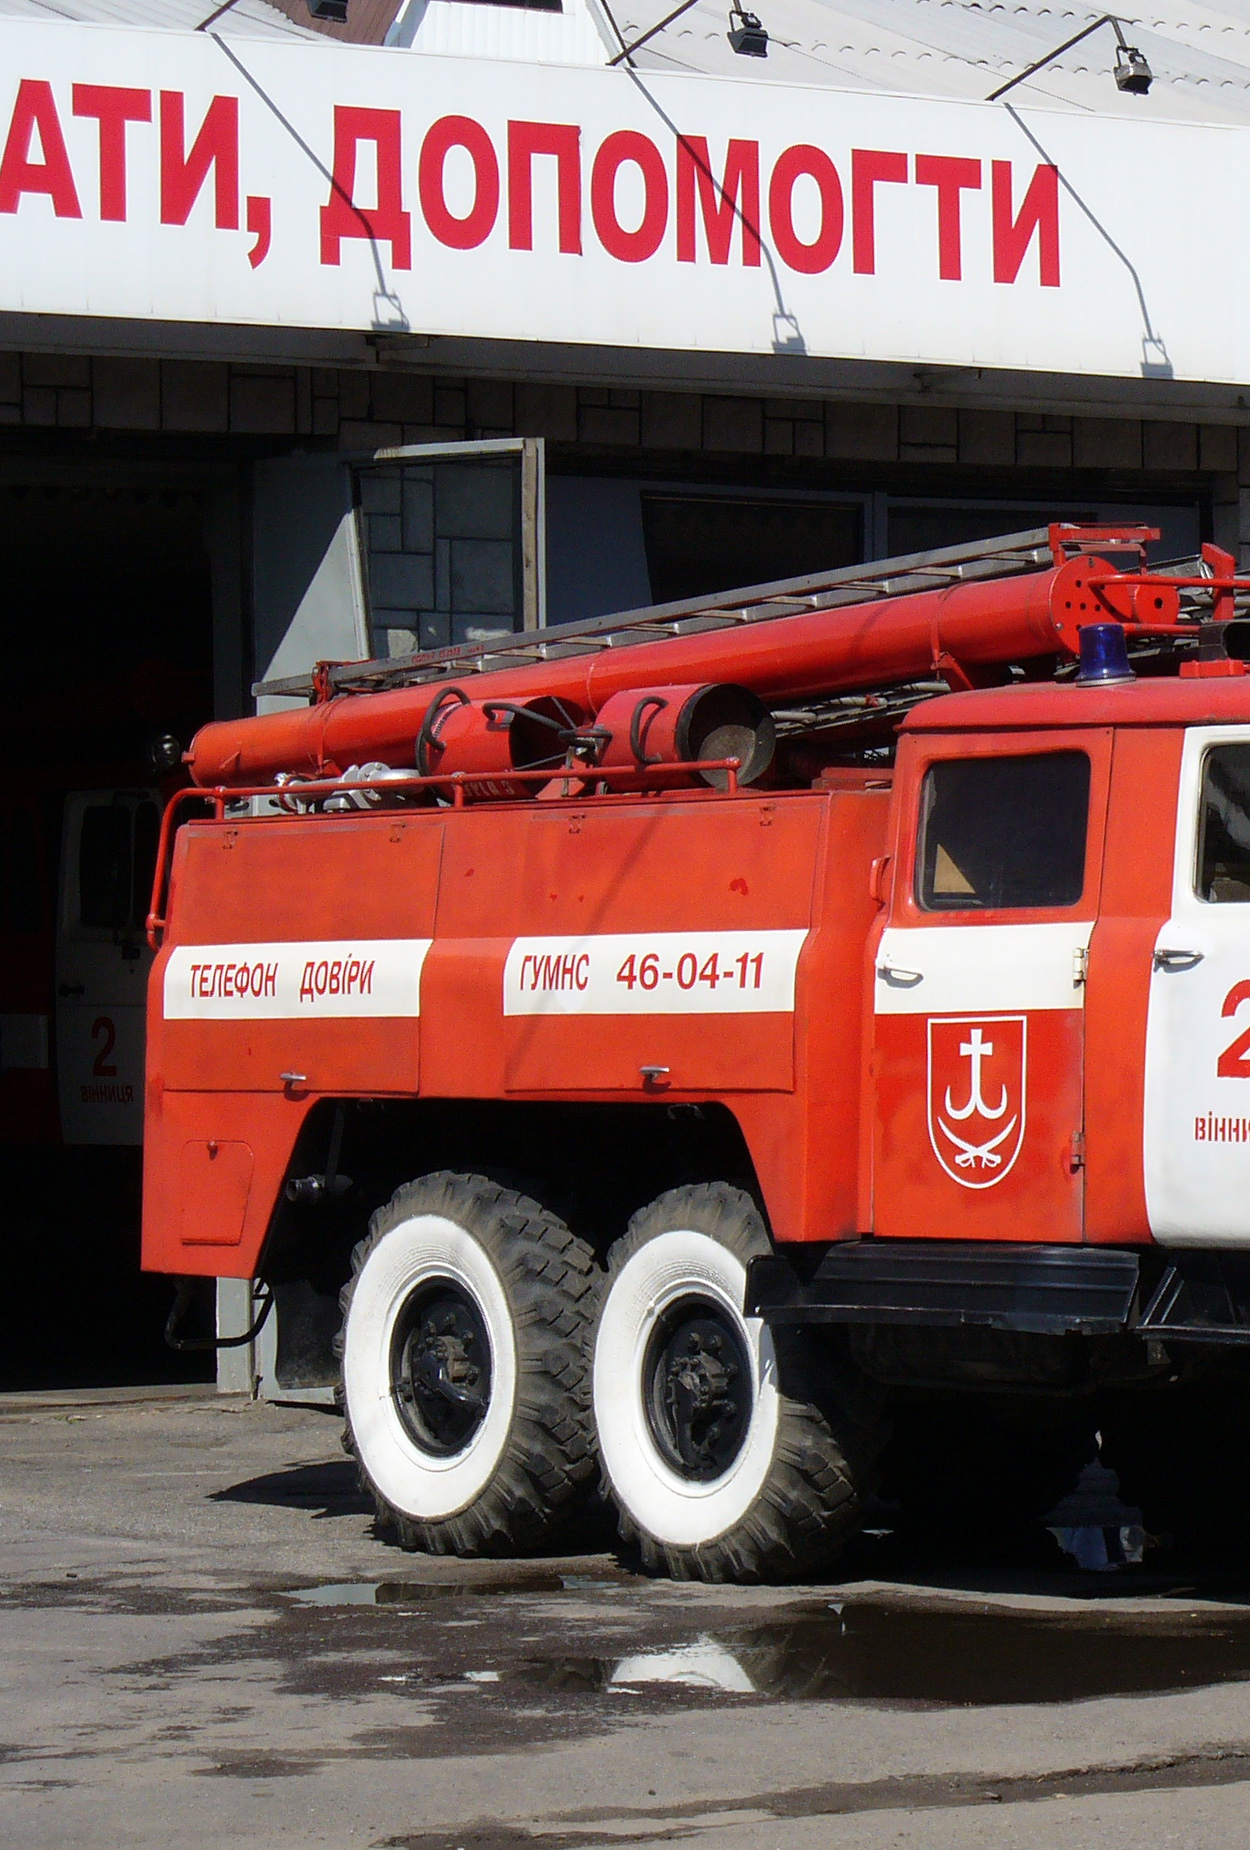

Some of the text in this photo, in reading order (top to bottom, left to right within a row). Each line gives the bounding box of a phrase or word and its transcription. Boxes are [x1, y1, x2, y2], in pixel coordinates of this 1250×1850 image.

[0, 79, 1061, 288] АТИ, ДОПОМОГТИ
[190, 953, 376, 1003] ТЕЛЕФОН ДОВІРИ
[519, 952, 765, 991] ГУМНС 46-04-11
[91, 1016, 117, 1077] 2
